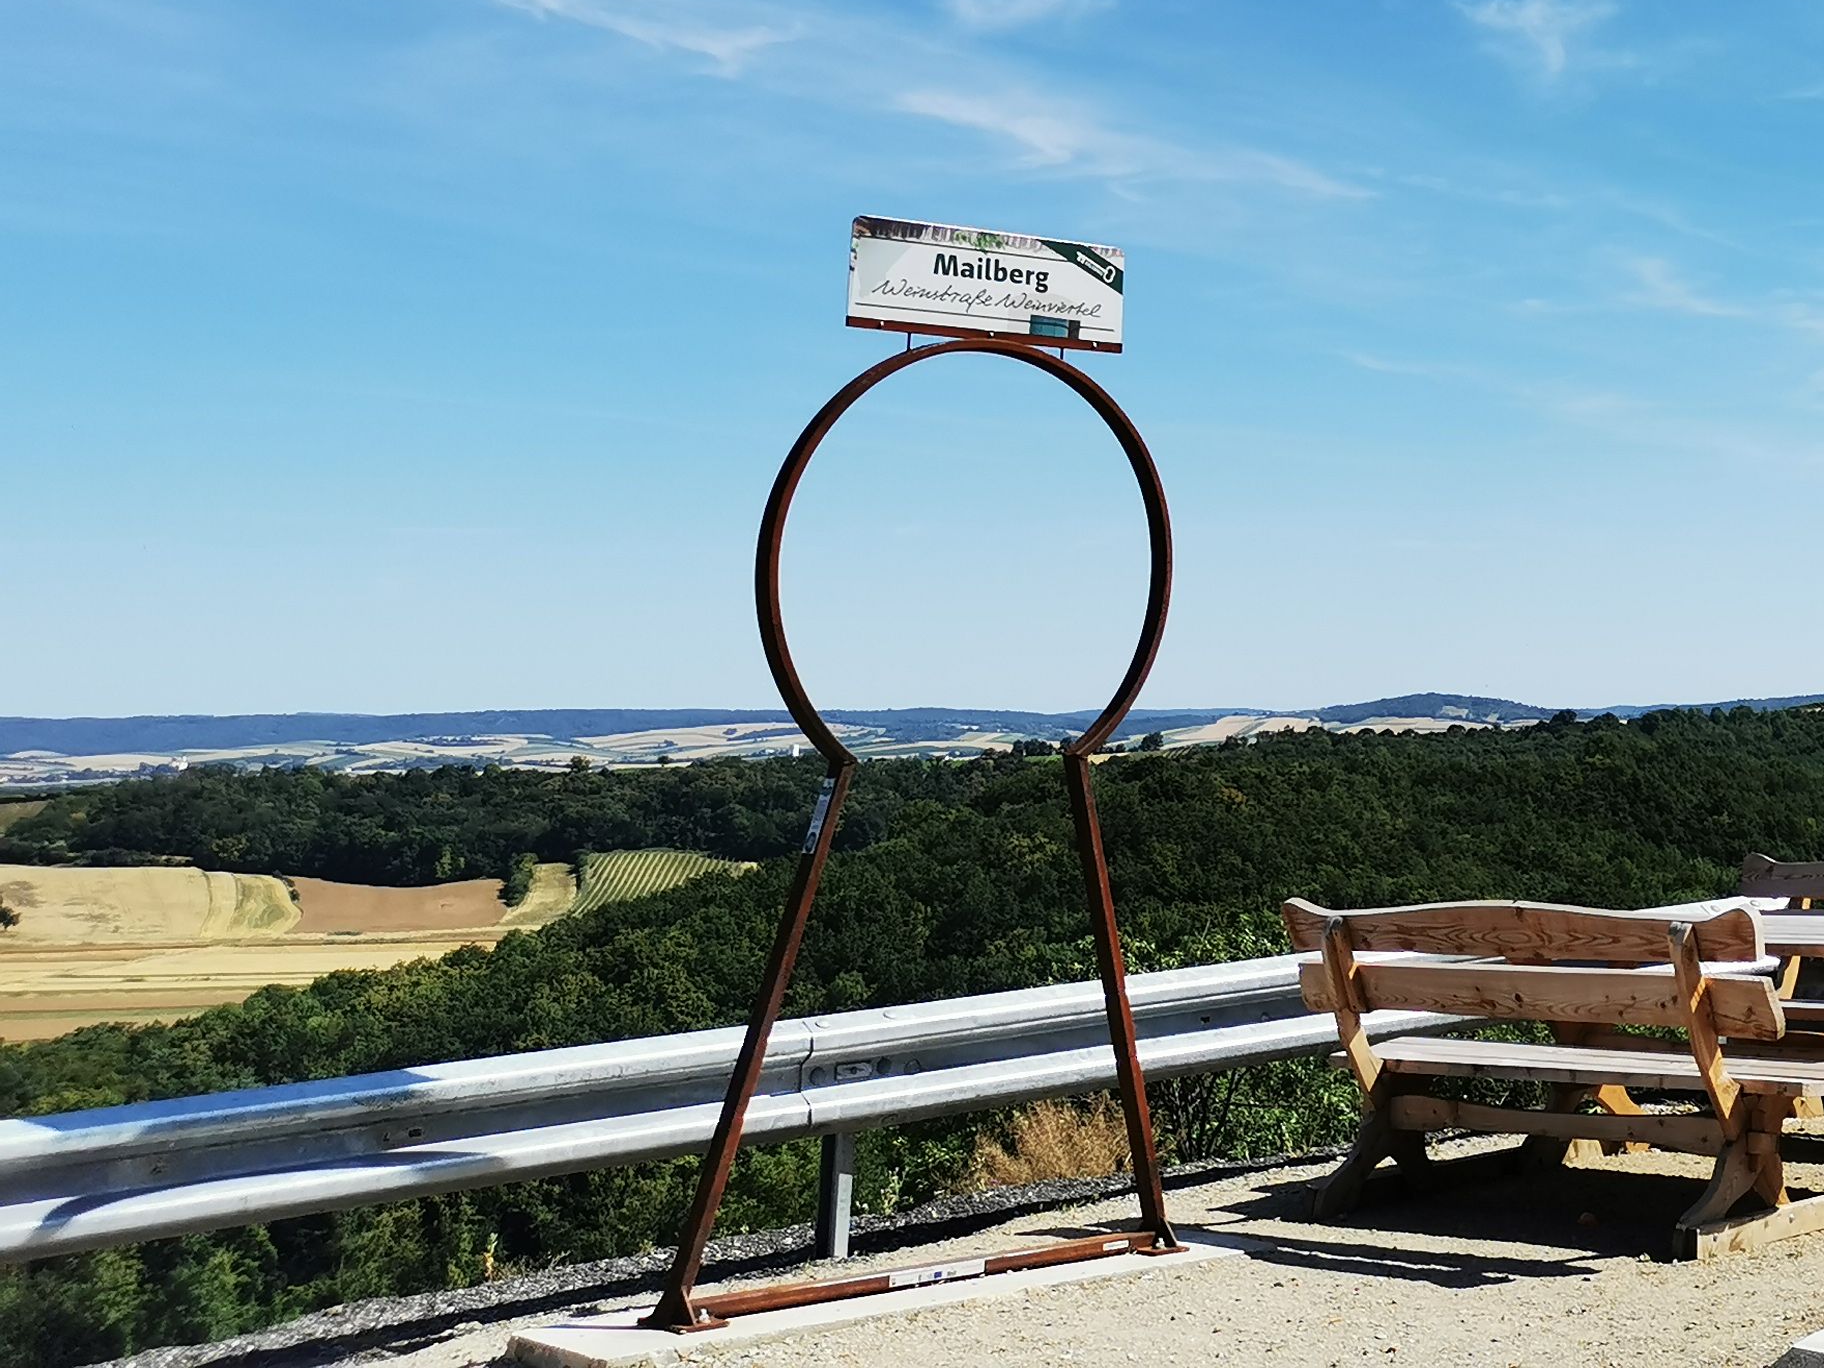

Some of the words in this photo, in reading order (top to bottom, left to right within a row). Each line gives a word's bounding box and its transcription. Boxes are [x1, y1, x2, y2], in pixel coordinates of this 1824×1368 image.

[933, 252, 1050, 293] Mailberg
[871, 278, 994, 314] Weinstraße
[997, 291, 1102, 318] Weinviertel
